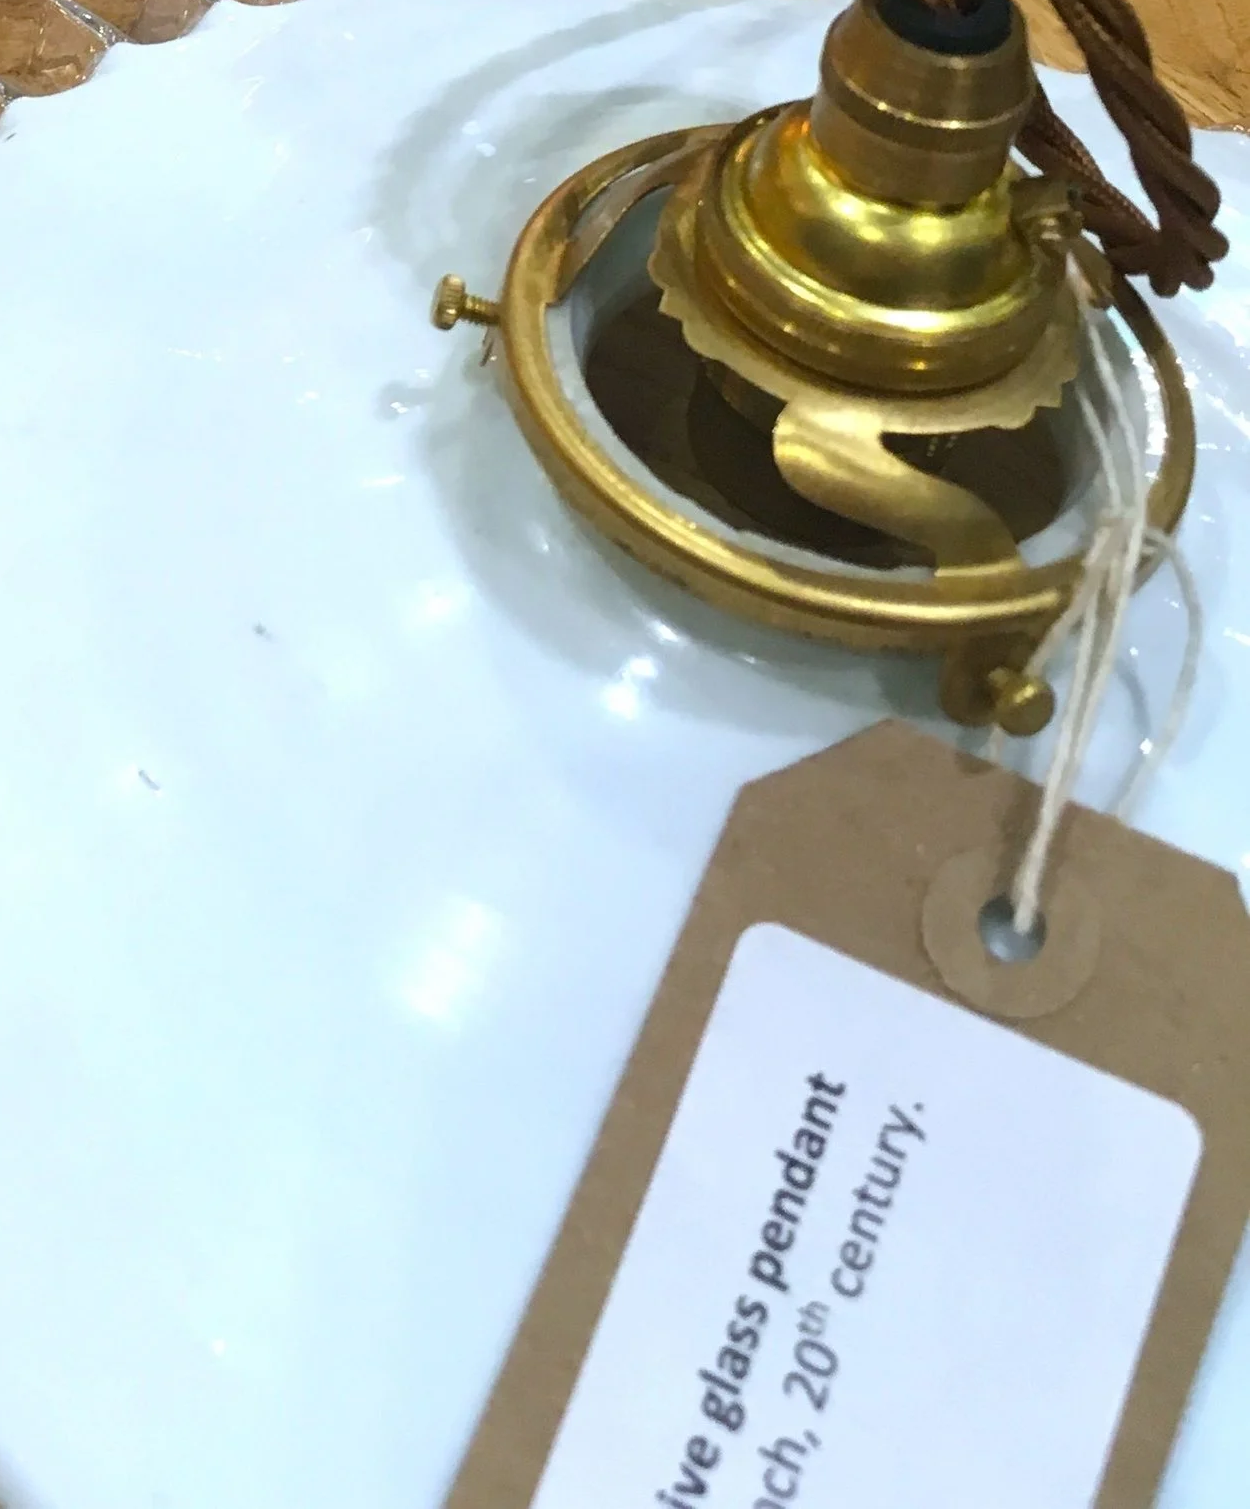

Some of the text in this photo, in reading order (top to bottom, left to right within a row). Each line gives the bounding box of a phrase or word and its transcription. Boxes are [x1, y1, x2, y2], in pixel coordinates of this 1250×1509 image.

[697, 1293, 768, 1433] glass
[749, 1071, 847, 1295] pendant
[782, 1301, 839, 1412] 20th
[830, 1100, 925, 1299] century.
